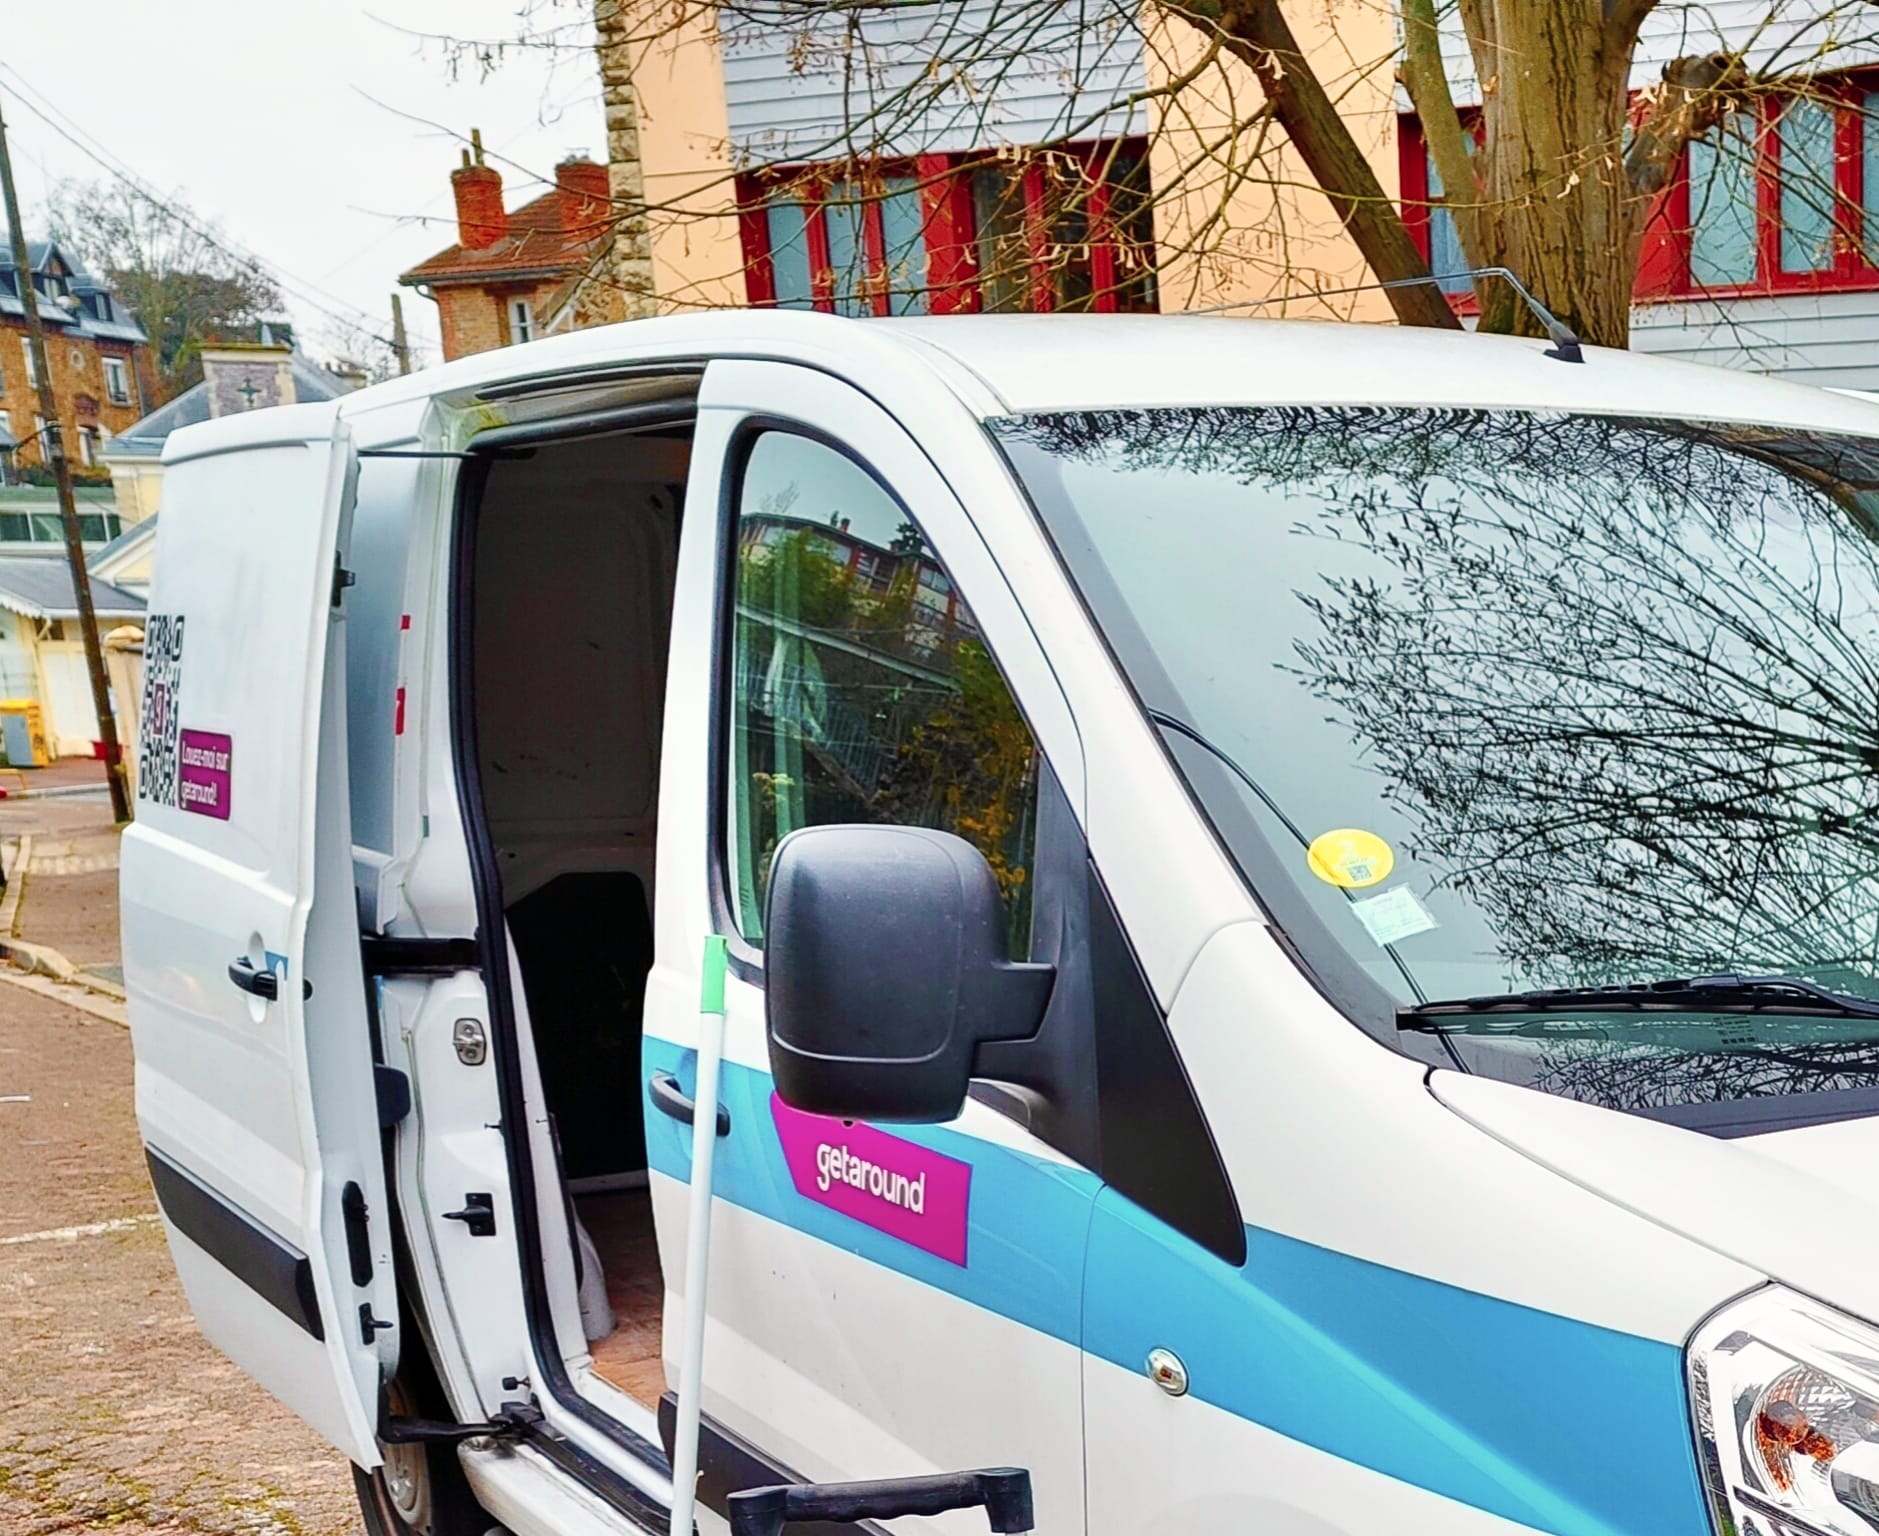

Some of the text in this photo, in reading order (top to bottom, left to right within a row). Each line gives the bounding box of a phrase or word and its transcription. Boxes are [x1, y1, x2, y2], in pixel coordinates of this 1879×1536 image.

[182, 740, 229, 772] Louez-moi sur
[816, 1143, 926, 1214] getaround
